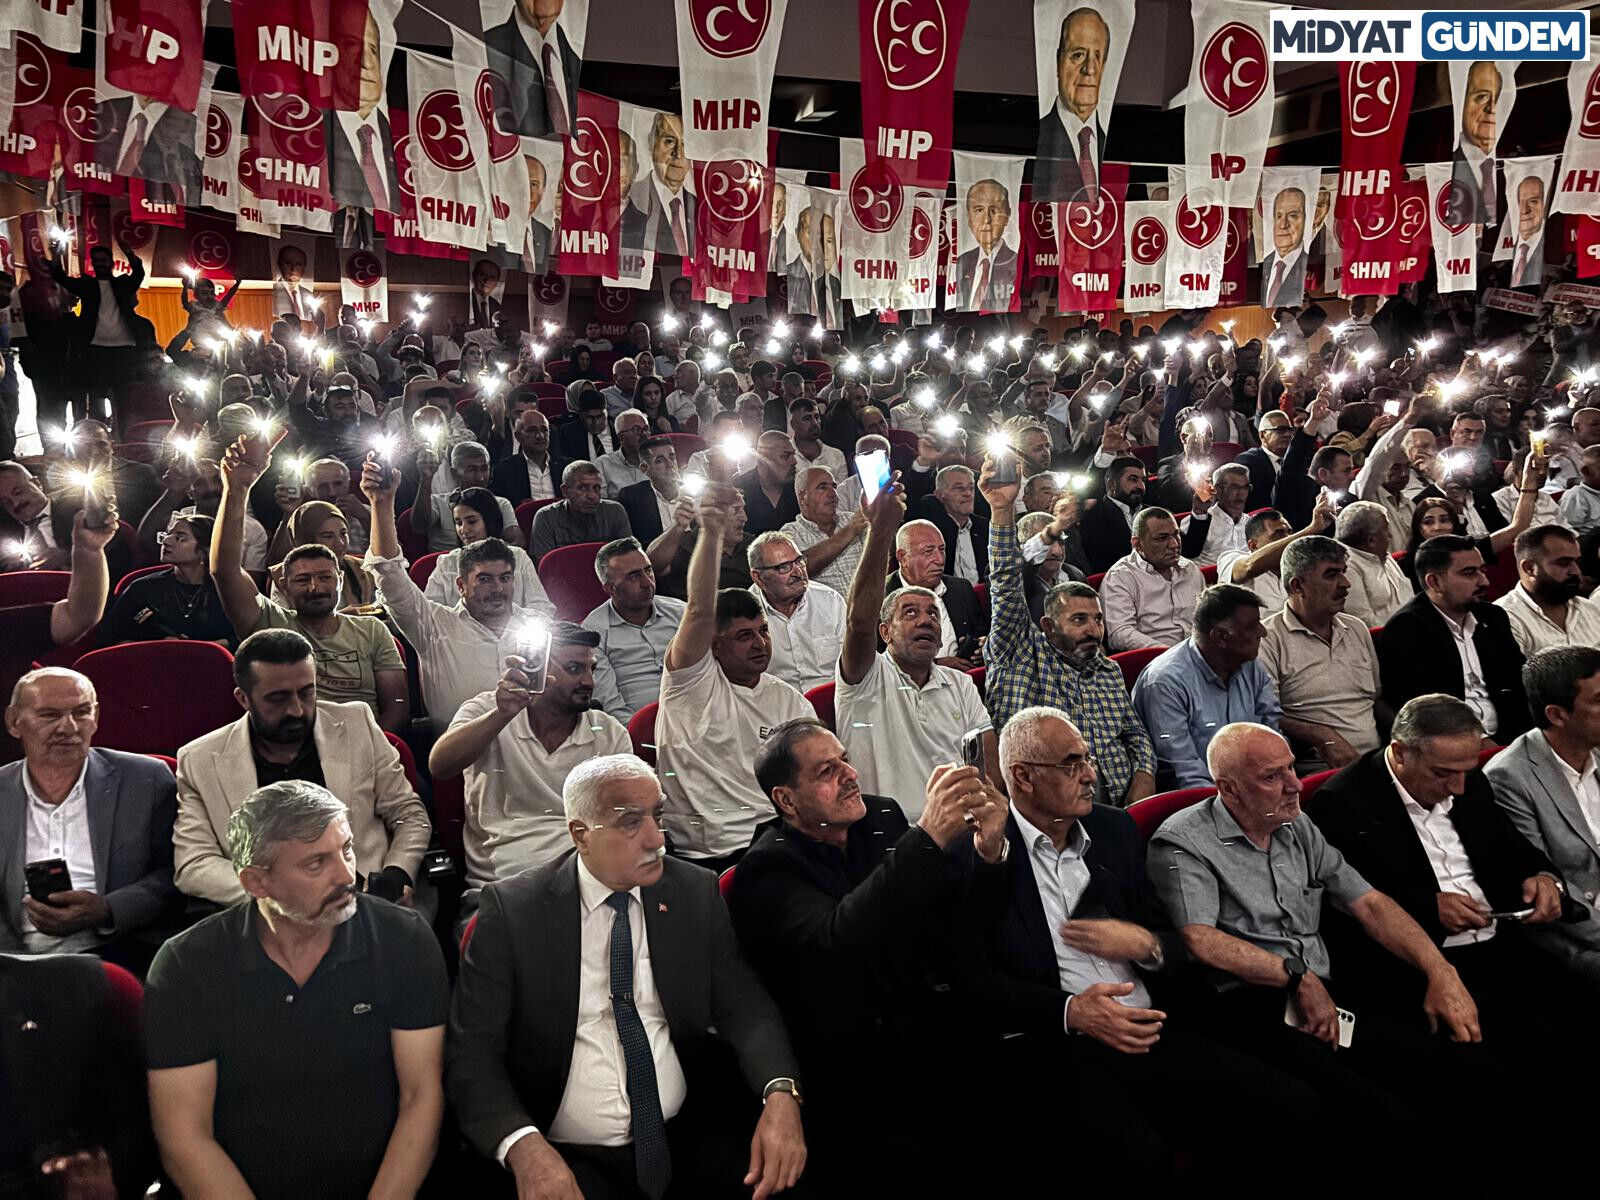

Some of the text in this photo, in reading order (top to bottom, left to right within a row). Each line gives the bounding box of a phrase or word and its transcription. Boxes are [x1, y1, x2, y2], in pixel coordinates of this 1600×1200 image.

[258, 25, 339, 76] MHP
[693, 99, 761, 131] MHP
[0, 132, 37, 154] HP
[622, 255, 645, 273] HP
[1130, 283, 1161, 298] MHP
[352, 301, 381, 314] MHP
